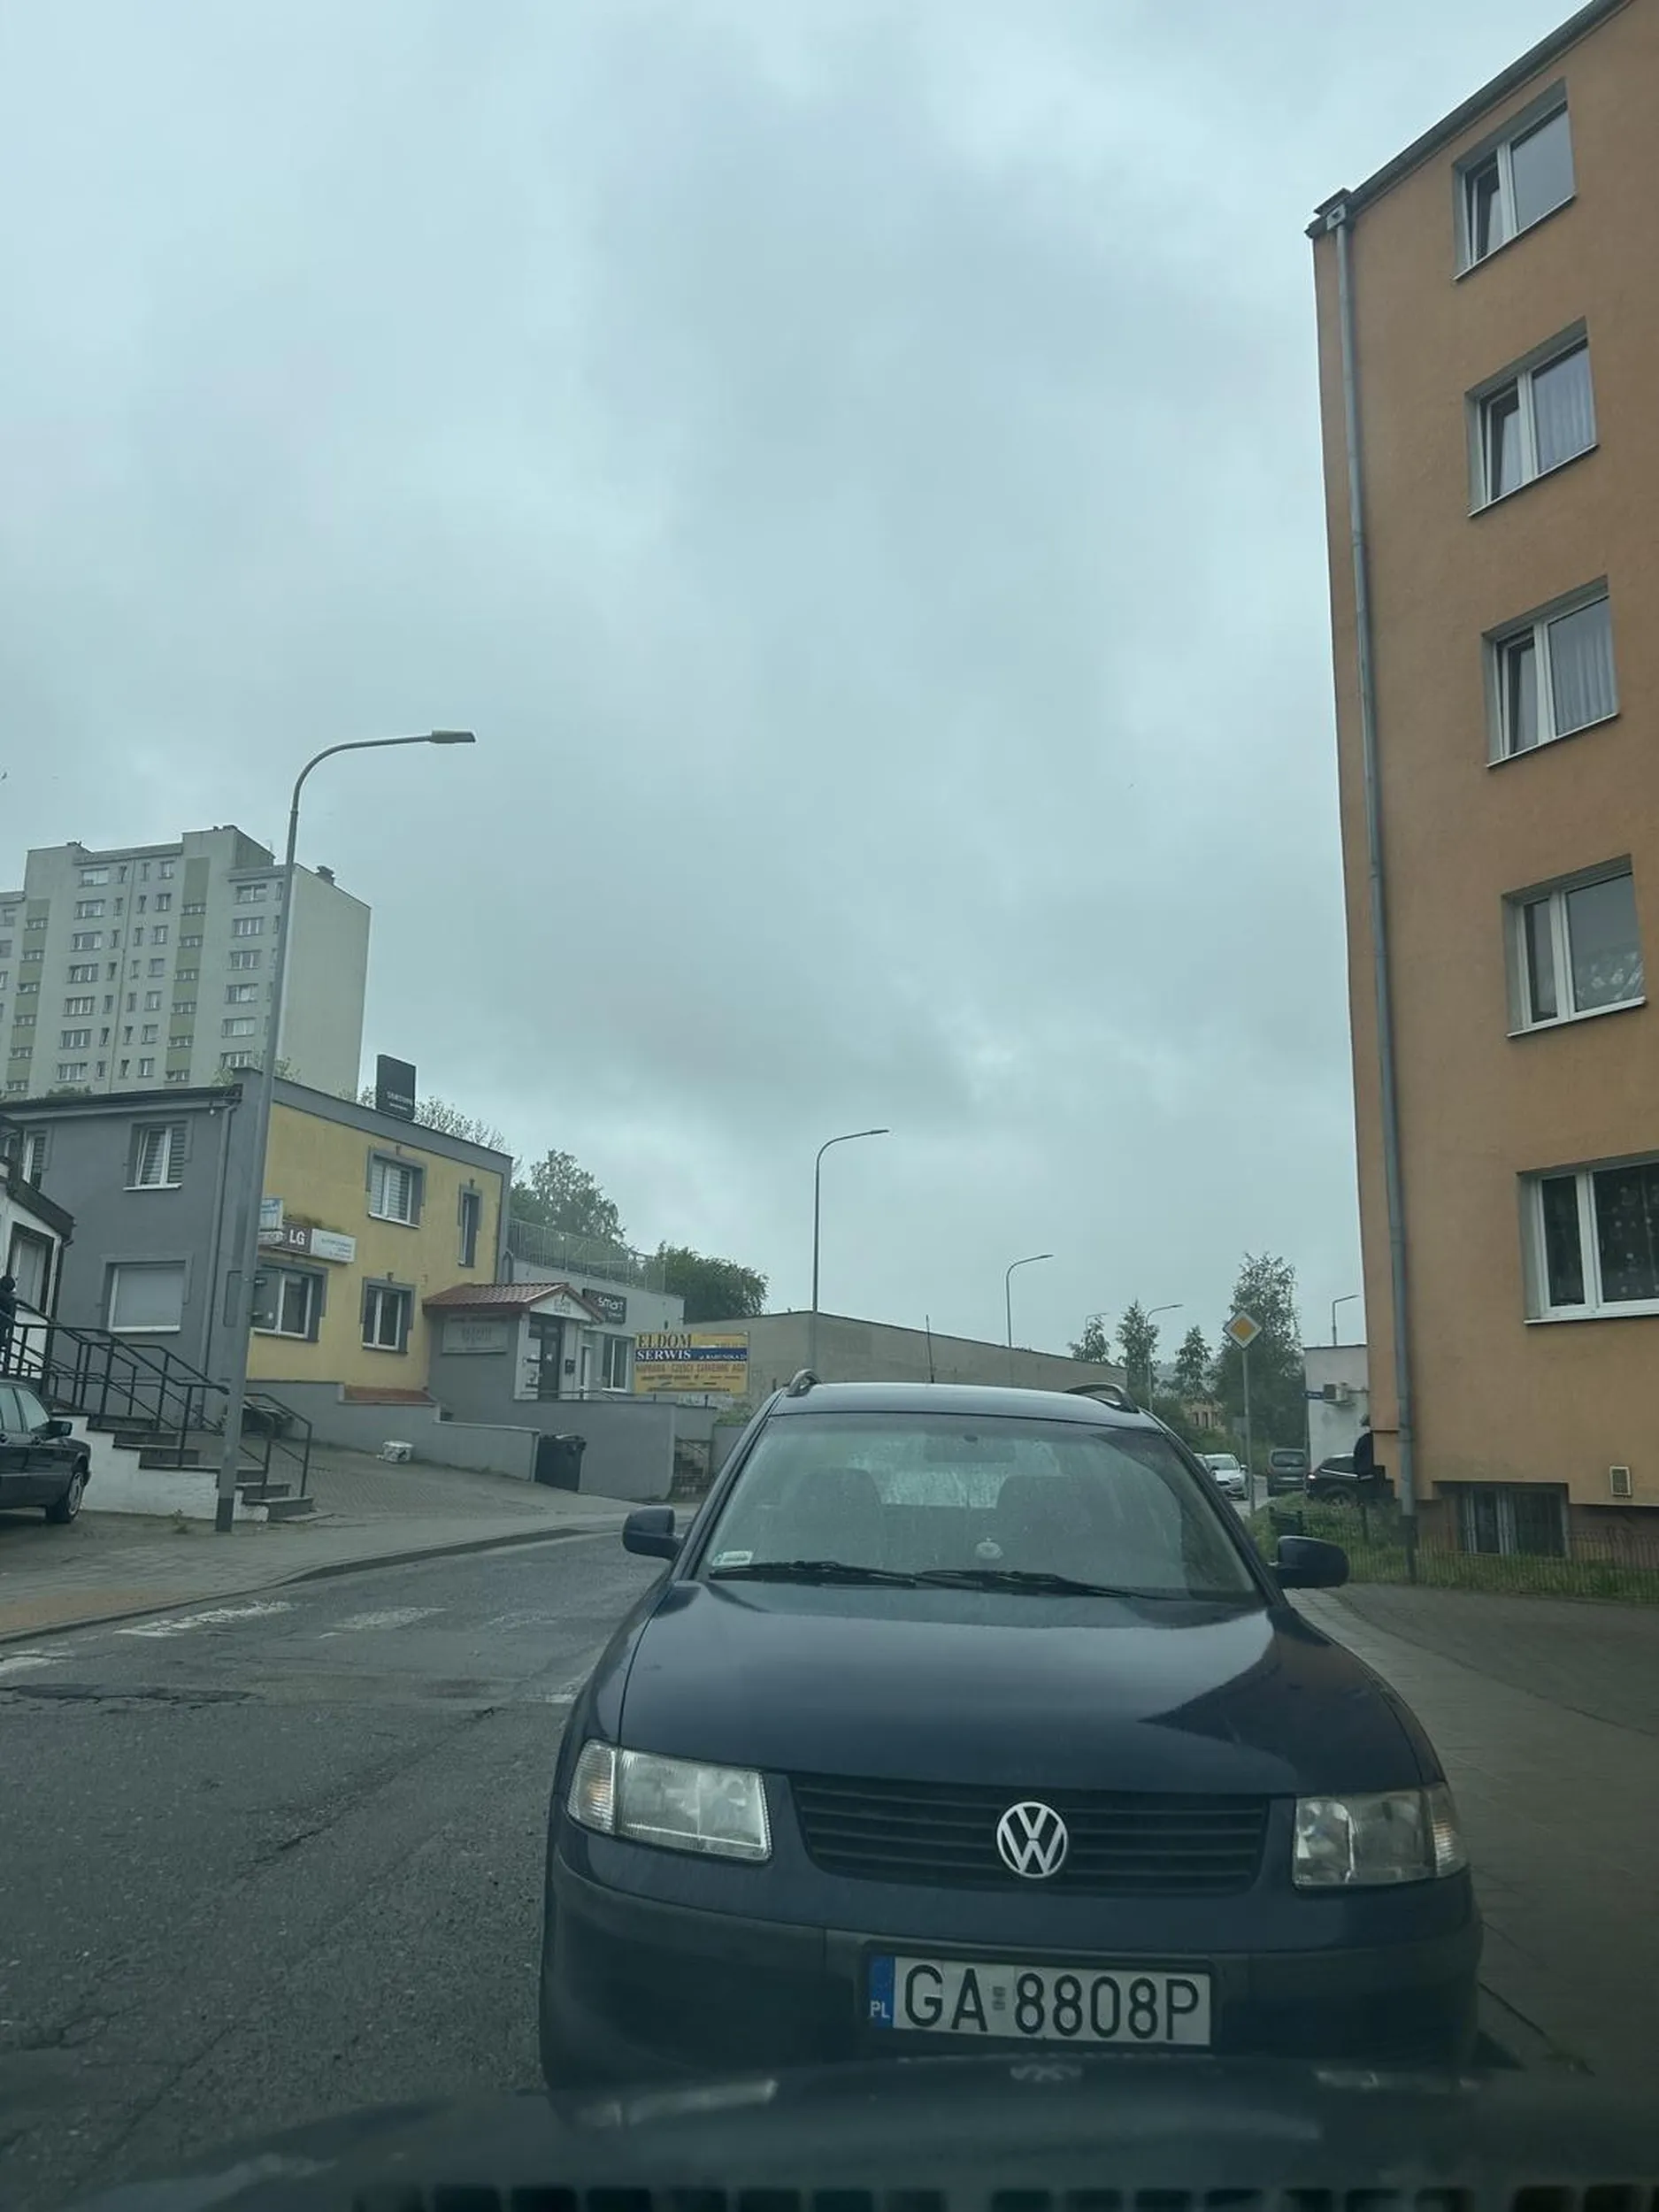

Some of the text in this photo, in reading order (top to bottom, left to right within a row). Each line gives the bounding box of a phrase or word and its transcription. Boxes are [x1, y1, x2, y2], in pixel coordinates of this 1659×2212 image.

[288, 1229, 305, 1246] LG
[638, 1333, 692, 1348] ELDOM
[636, 1349, 692, 1361] SERWIS
[996, 1801, 1068, 1878] VW
[870, 2000, 890, 2018] PL
[904, 1963, 1200, 2041] GA 8808P
